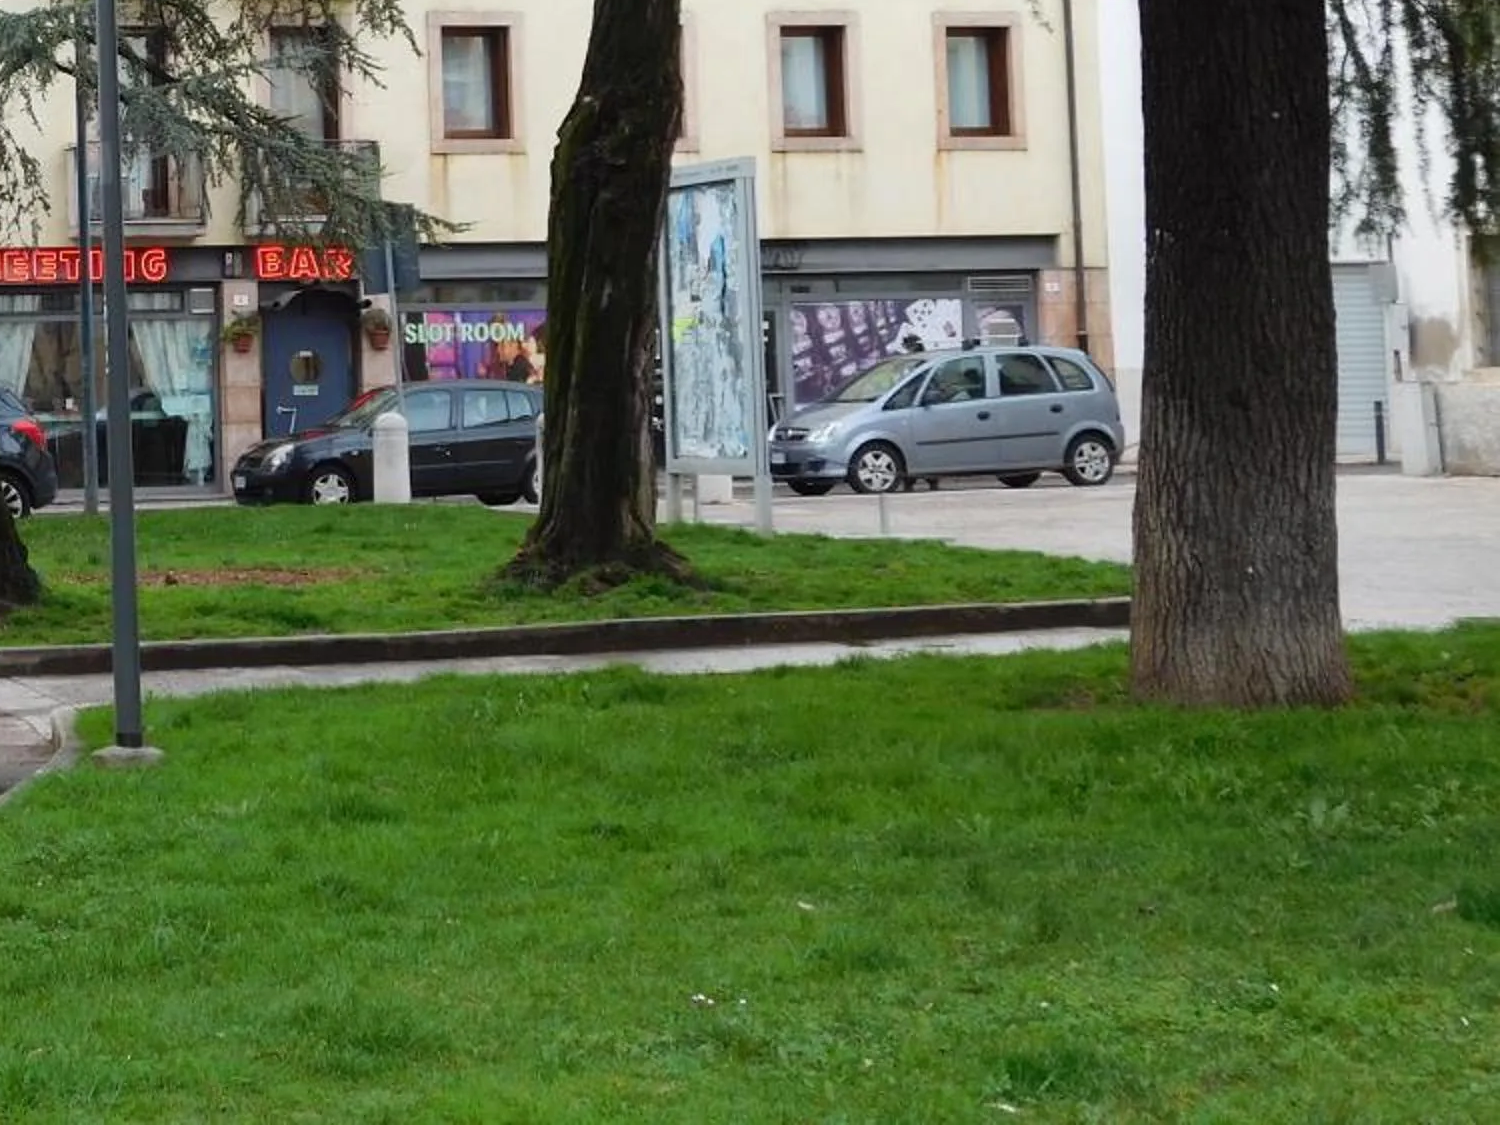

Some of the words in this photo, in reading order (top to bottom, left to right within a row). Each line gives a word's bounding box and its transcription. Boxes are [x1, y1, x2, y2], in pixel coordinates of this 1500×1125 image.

[257, 246, 354, 279] BAR
[404, 322, 455, 344] SLOT
[461, 321, 525, 343] ROOM
